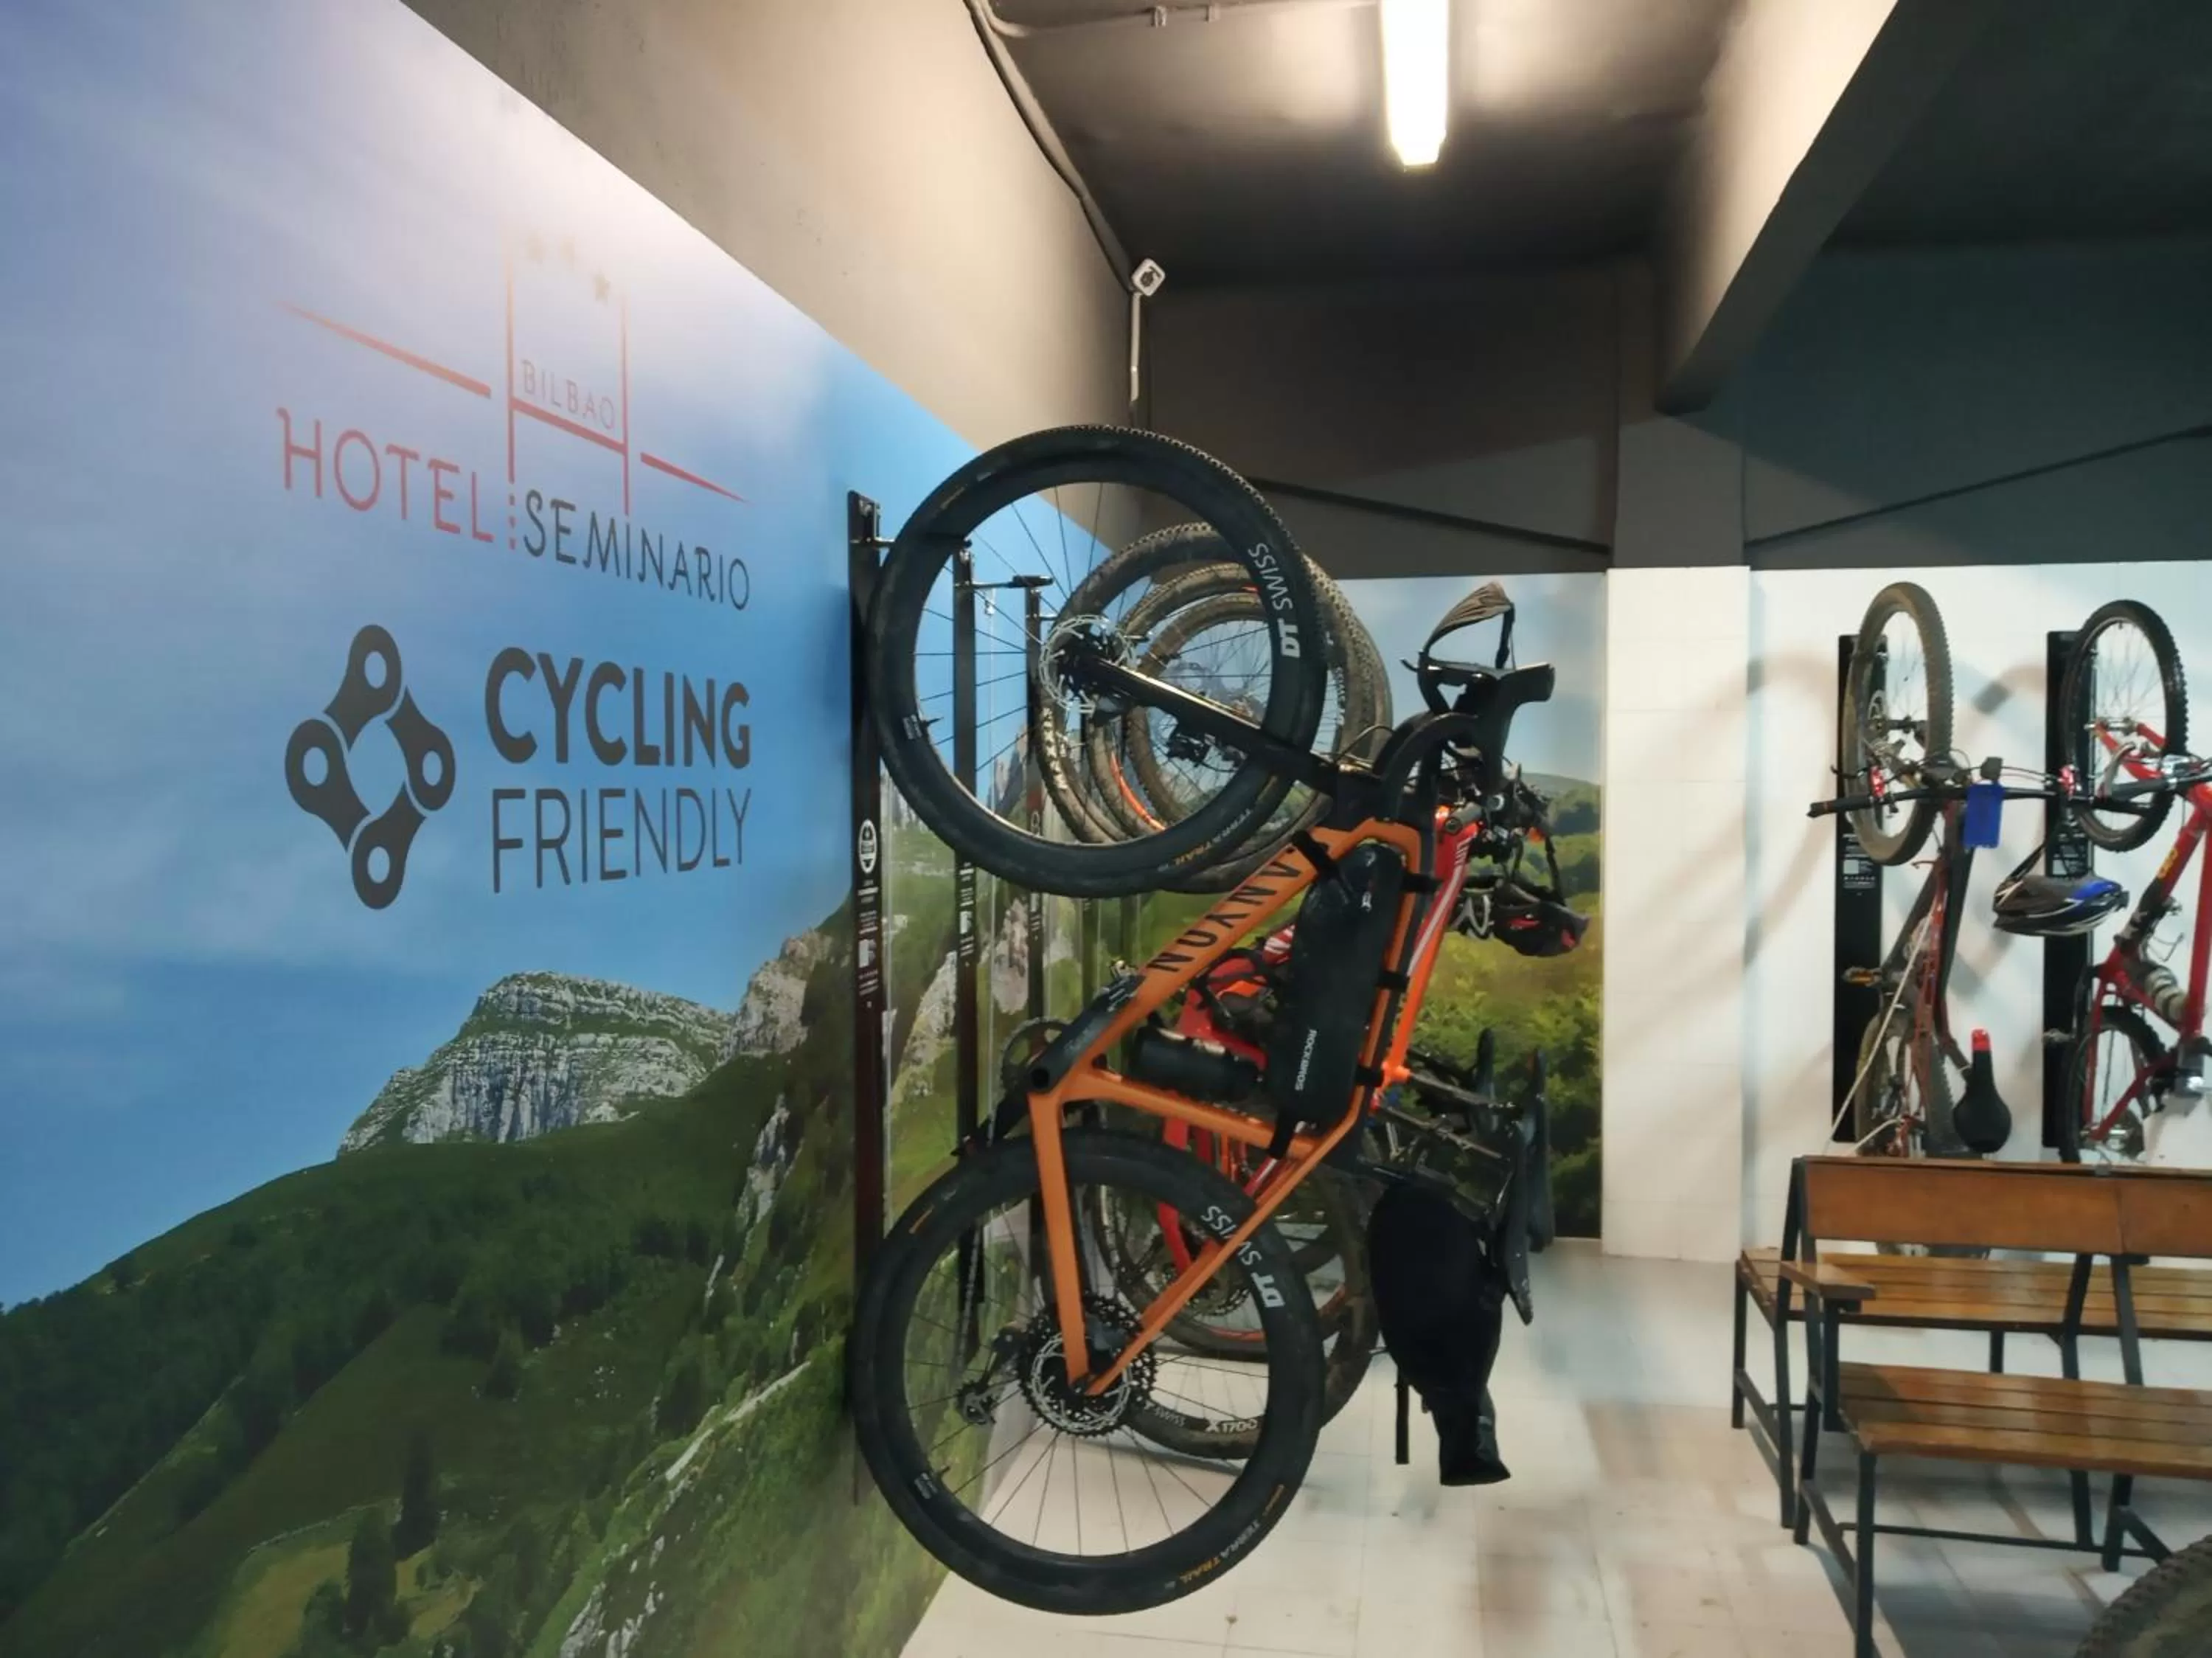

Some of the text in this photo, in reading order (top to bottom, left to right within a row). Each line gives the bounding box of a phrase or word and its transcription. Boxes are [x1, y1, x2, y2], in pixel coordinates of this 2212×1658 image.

[521, 359, 615, 430] BILBAO
[277, 407, 750, 611] HOTEL SEMINARIO
[1248, 542, 1301, 659] DT SWISS
[484, 647, 751, 769] CYCLING
[492, 788, 751, 894] FRIENDLY
[1146, 847, 1301, 972] ANYON
[1294, 1029, 1317, 1091] ROCKBROS
[1251, 1272, 1286, 1308] DT
